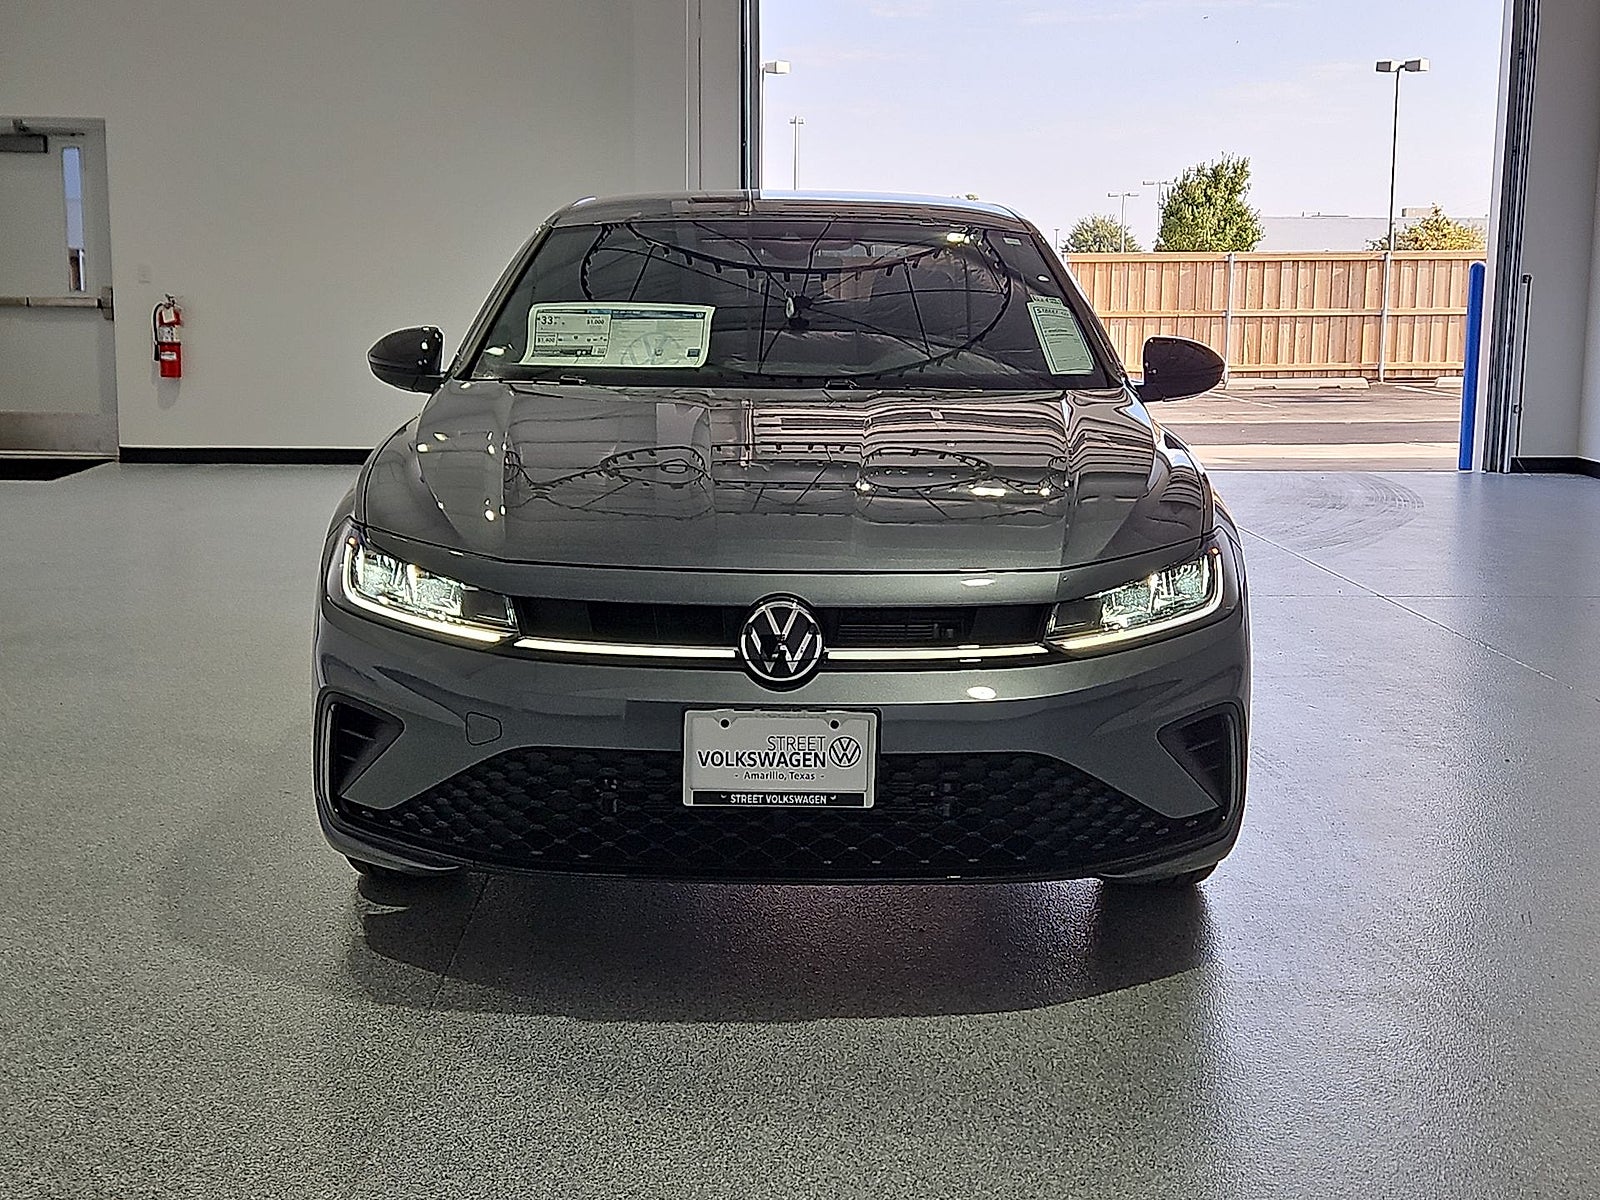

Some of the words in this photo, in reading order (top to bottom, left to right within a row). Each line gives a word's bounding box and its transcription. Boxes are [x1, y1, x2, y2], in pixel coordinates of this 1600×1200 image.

[767, 735, 826, 751] STREET
[698, 751, 826, 768] VOLKSWAGEN
[743, 771, 787, 781] Amarillo,
[789, 771, 816, 780] Texas
[730, 795, 763, 803] STREET
[765, 795, 827, 804] VOLKSWAGEN
